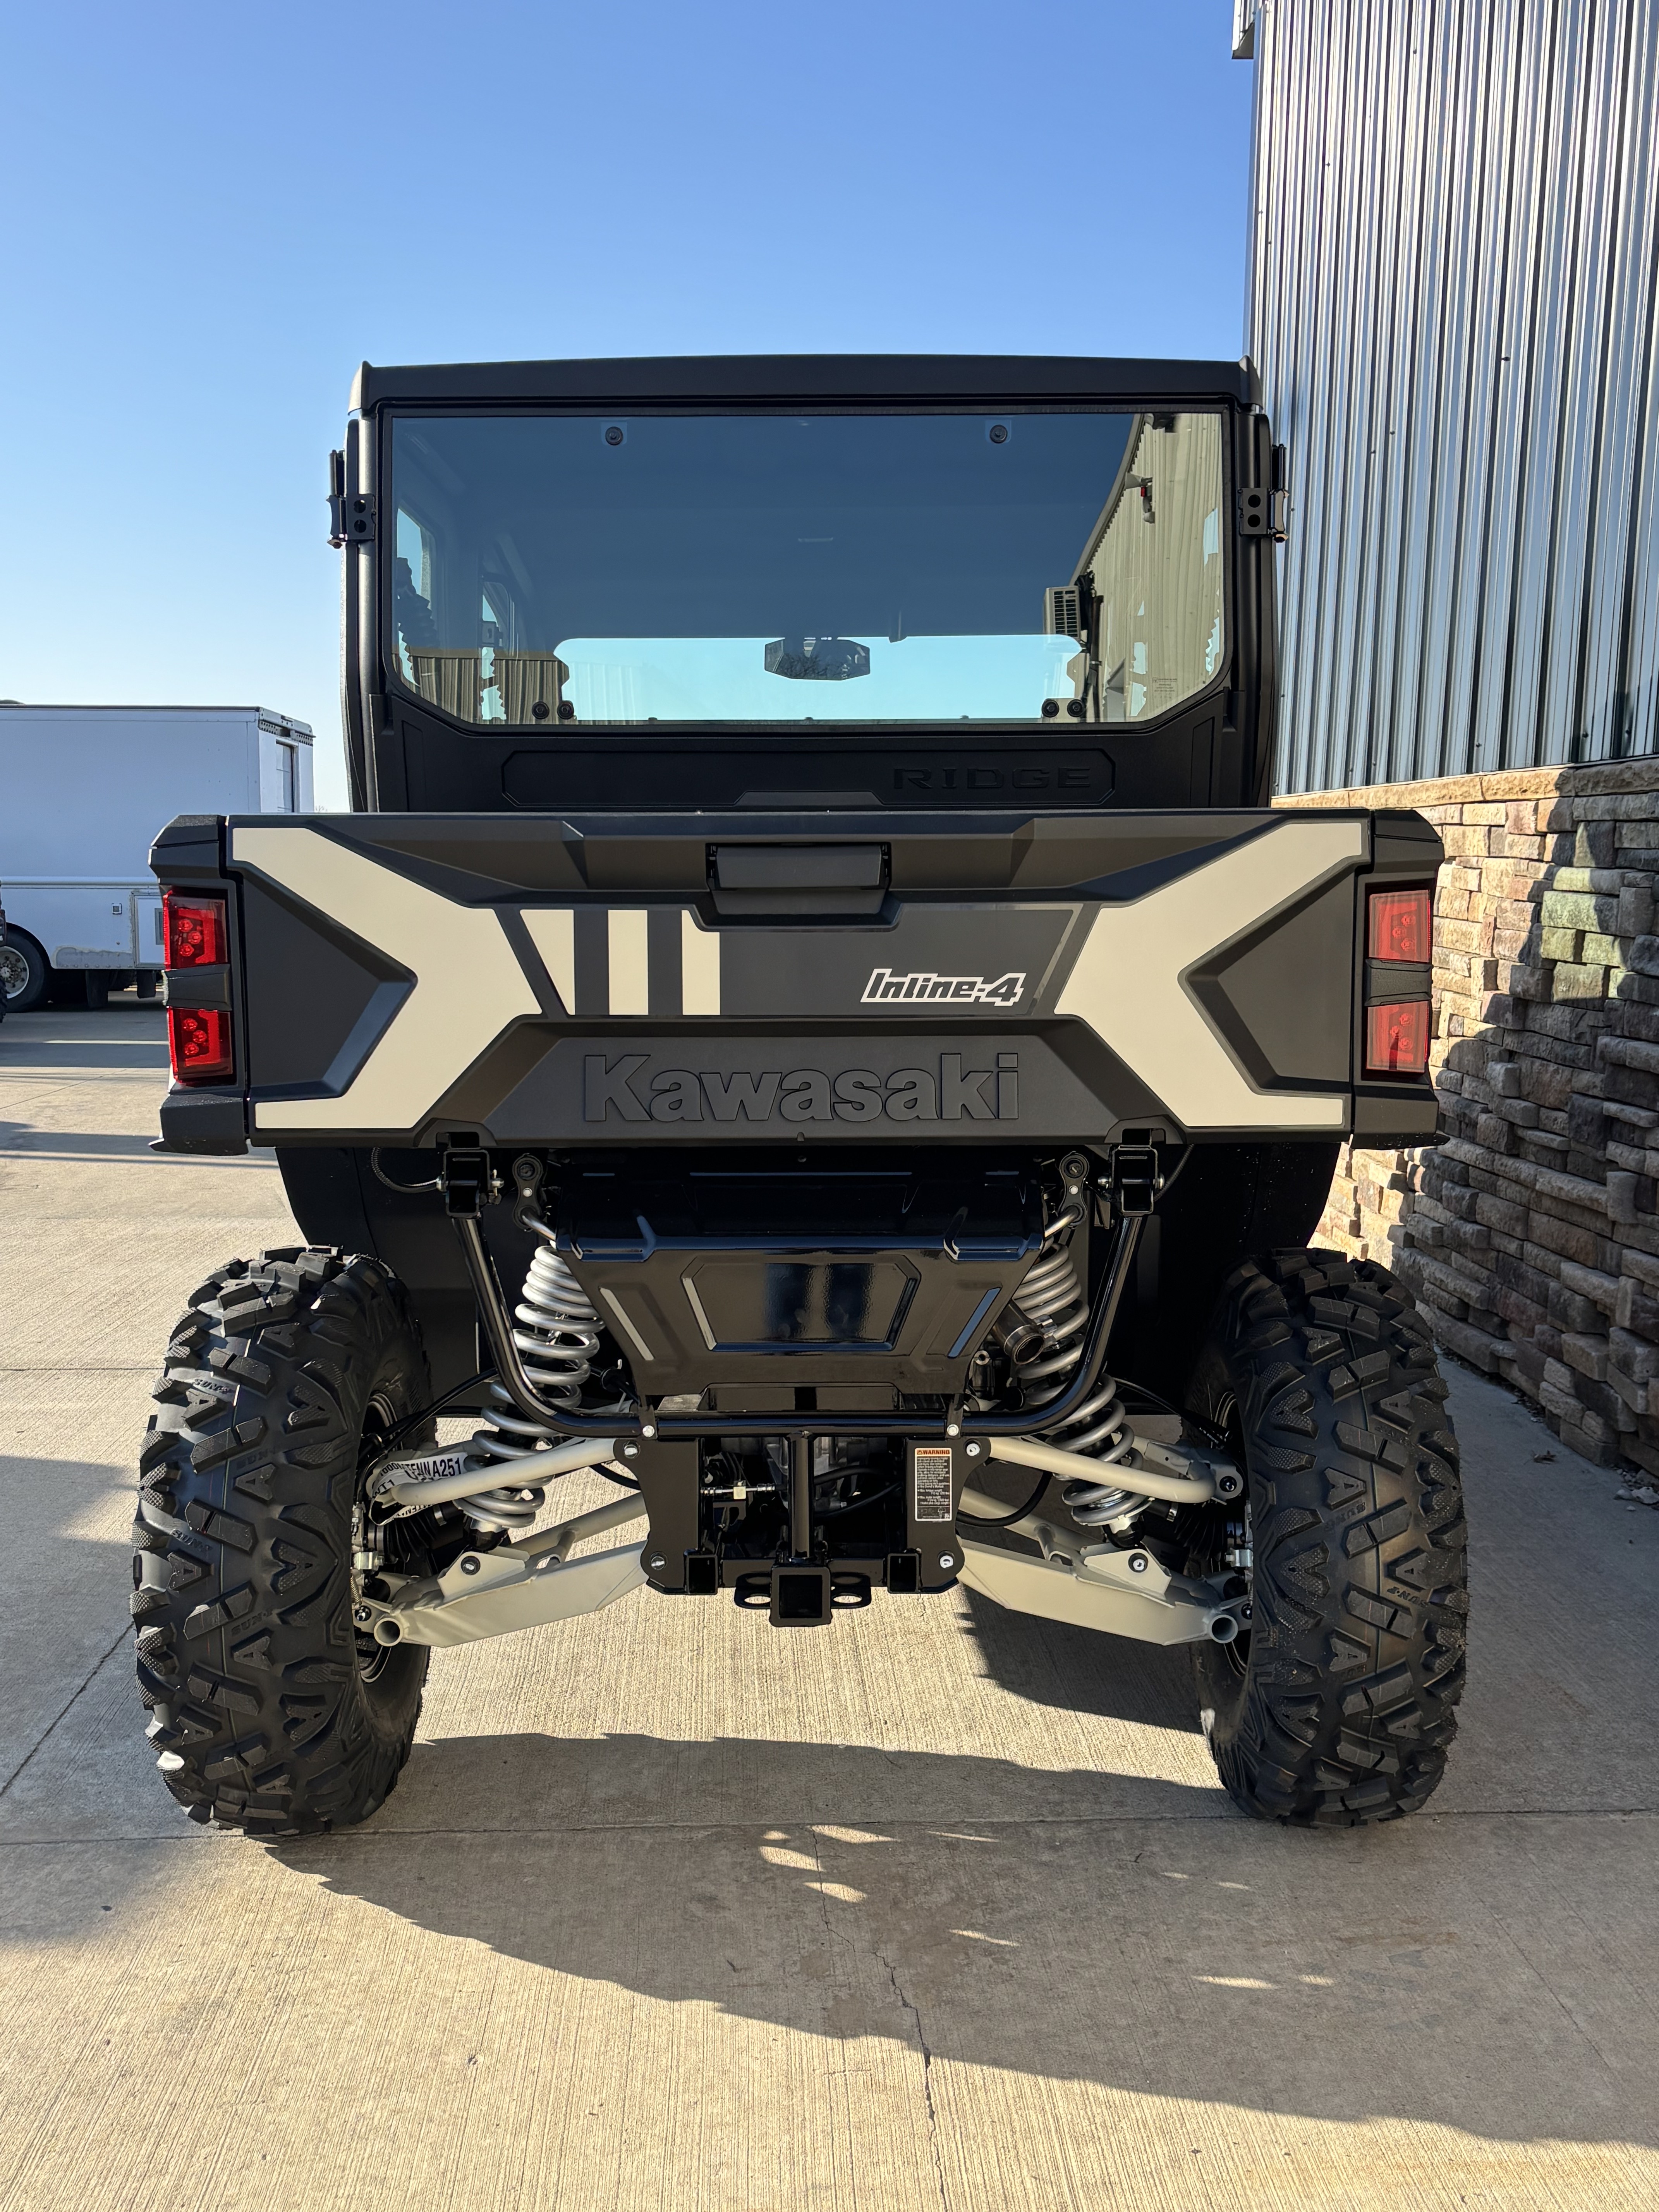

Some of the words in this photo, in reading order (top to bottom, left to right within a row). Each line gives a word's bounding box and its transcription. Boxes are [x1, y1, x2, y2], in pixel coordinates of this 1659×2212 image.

[894, 767, 1091, 789] RIDGE
[860, 968, 1026, 1006] Inline-4
[584, 1052, 1019, 1122] Kawasaki
